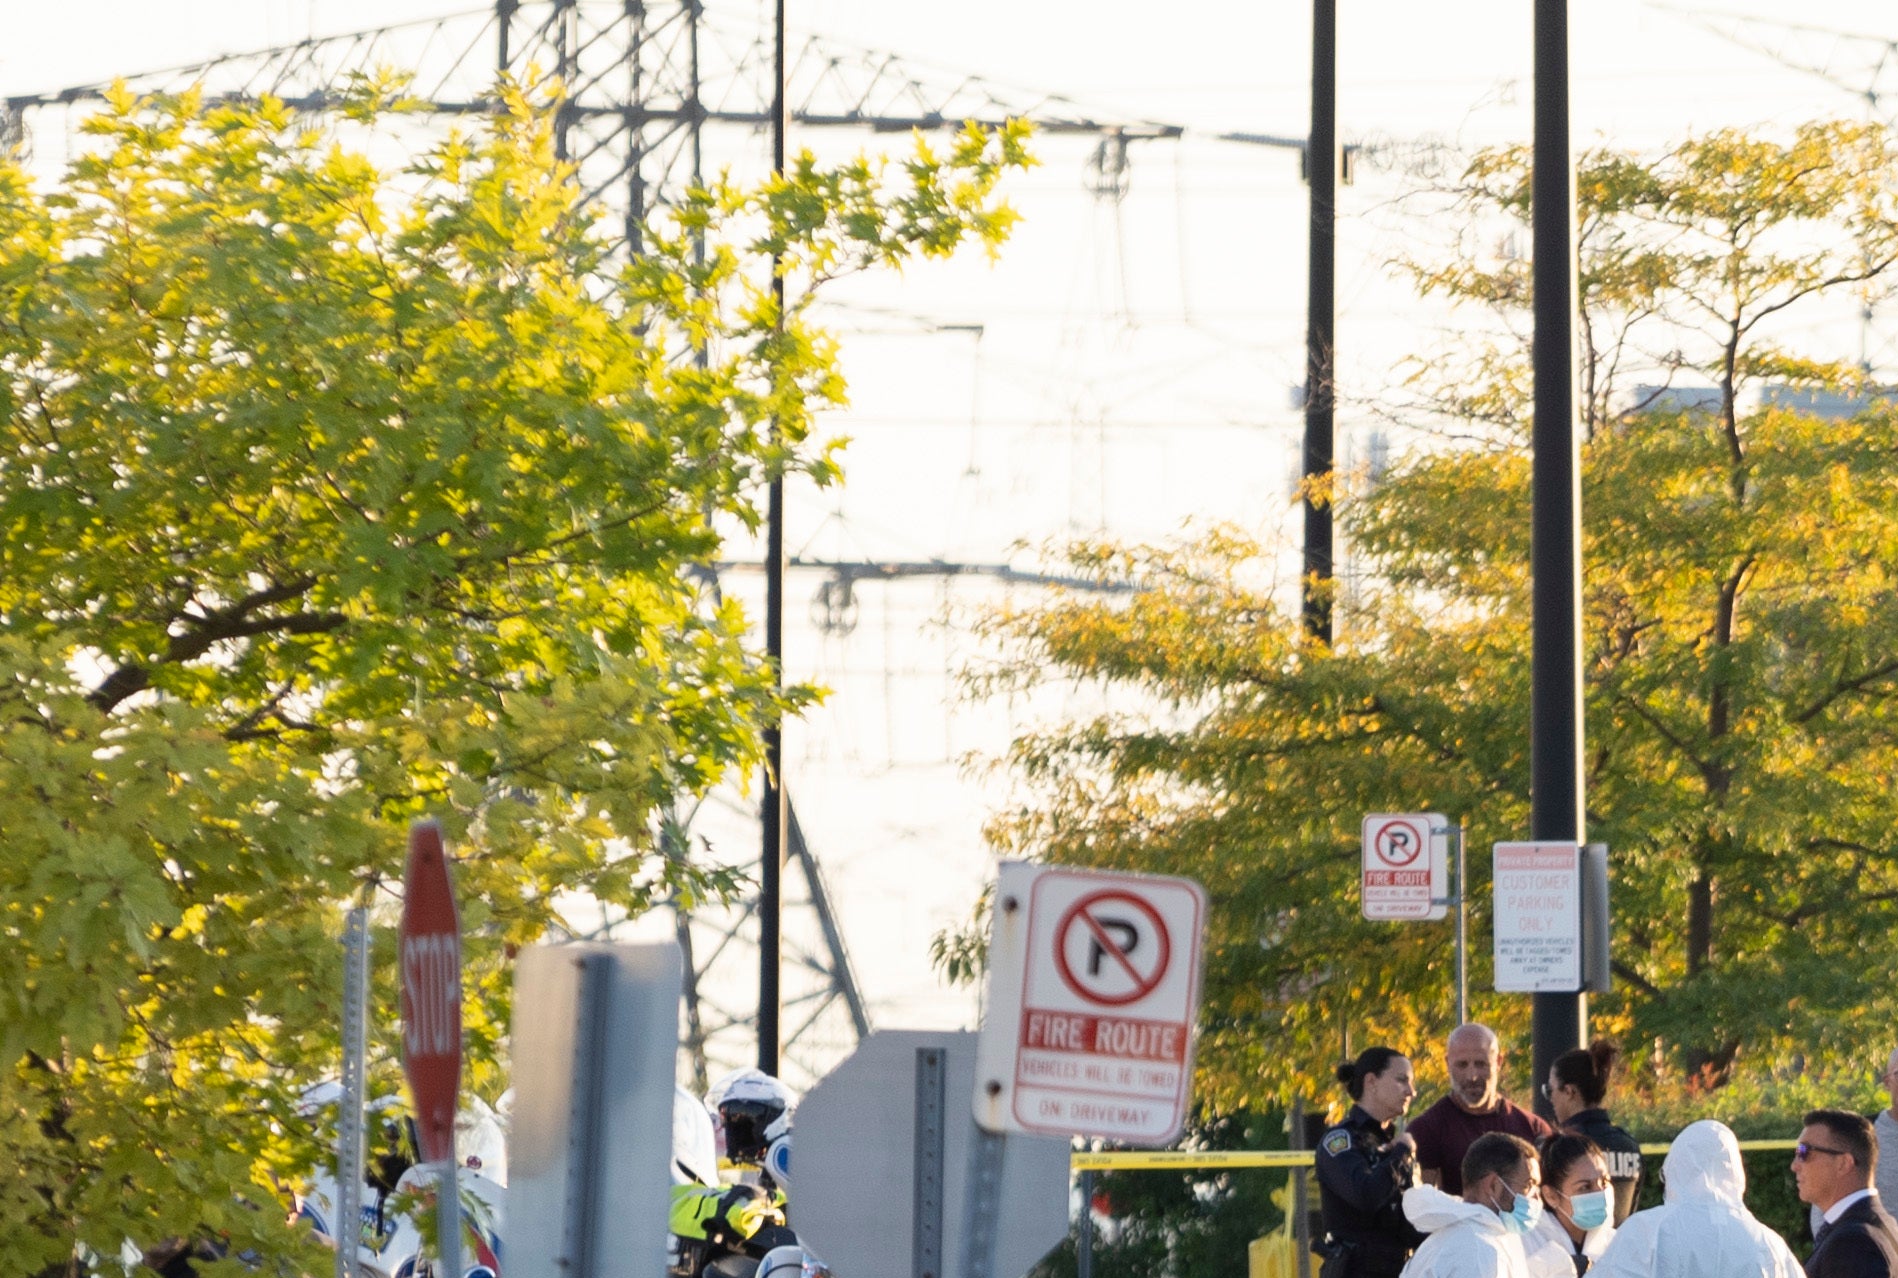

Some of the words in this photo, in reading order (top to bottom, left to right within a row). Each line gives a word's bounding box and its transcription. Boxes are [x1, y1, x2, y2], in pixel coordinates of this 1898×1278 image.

[1367, 872, 1389, 886] FIRE
[1394, 872, 1428, 887] ROUTE
[1502, 875, 1570, 889] CUSTOMER
[1507, 896, 1564, 910] PARKING
[1519, 917, 1553, 931] ONLY
[404, 933, 457, 1057] STOP
[1027, 1012, 1084, 1050] FIRE
[1095, 1019, 1177, 1058] ROUTE
[1022, 1058, 1078, 1079] VEHICLES
[1039, 1100, 1061, 1116] ON
[1070, 1103, 1150, 1125] DRIVEWAY
